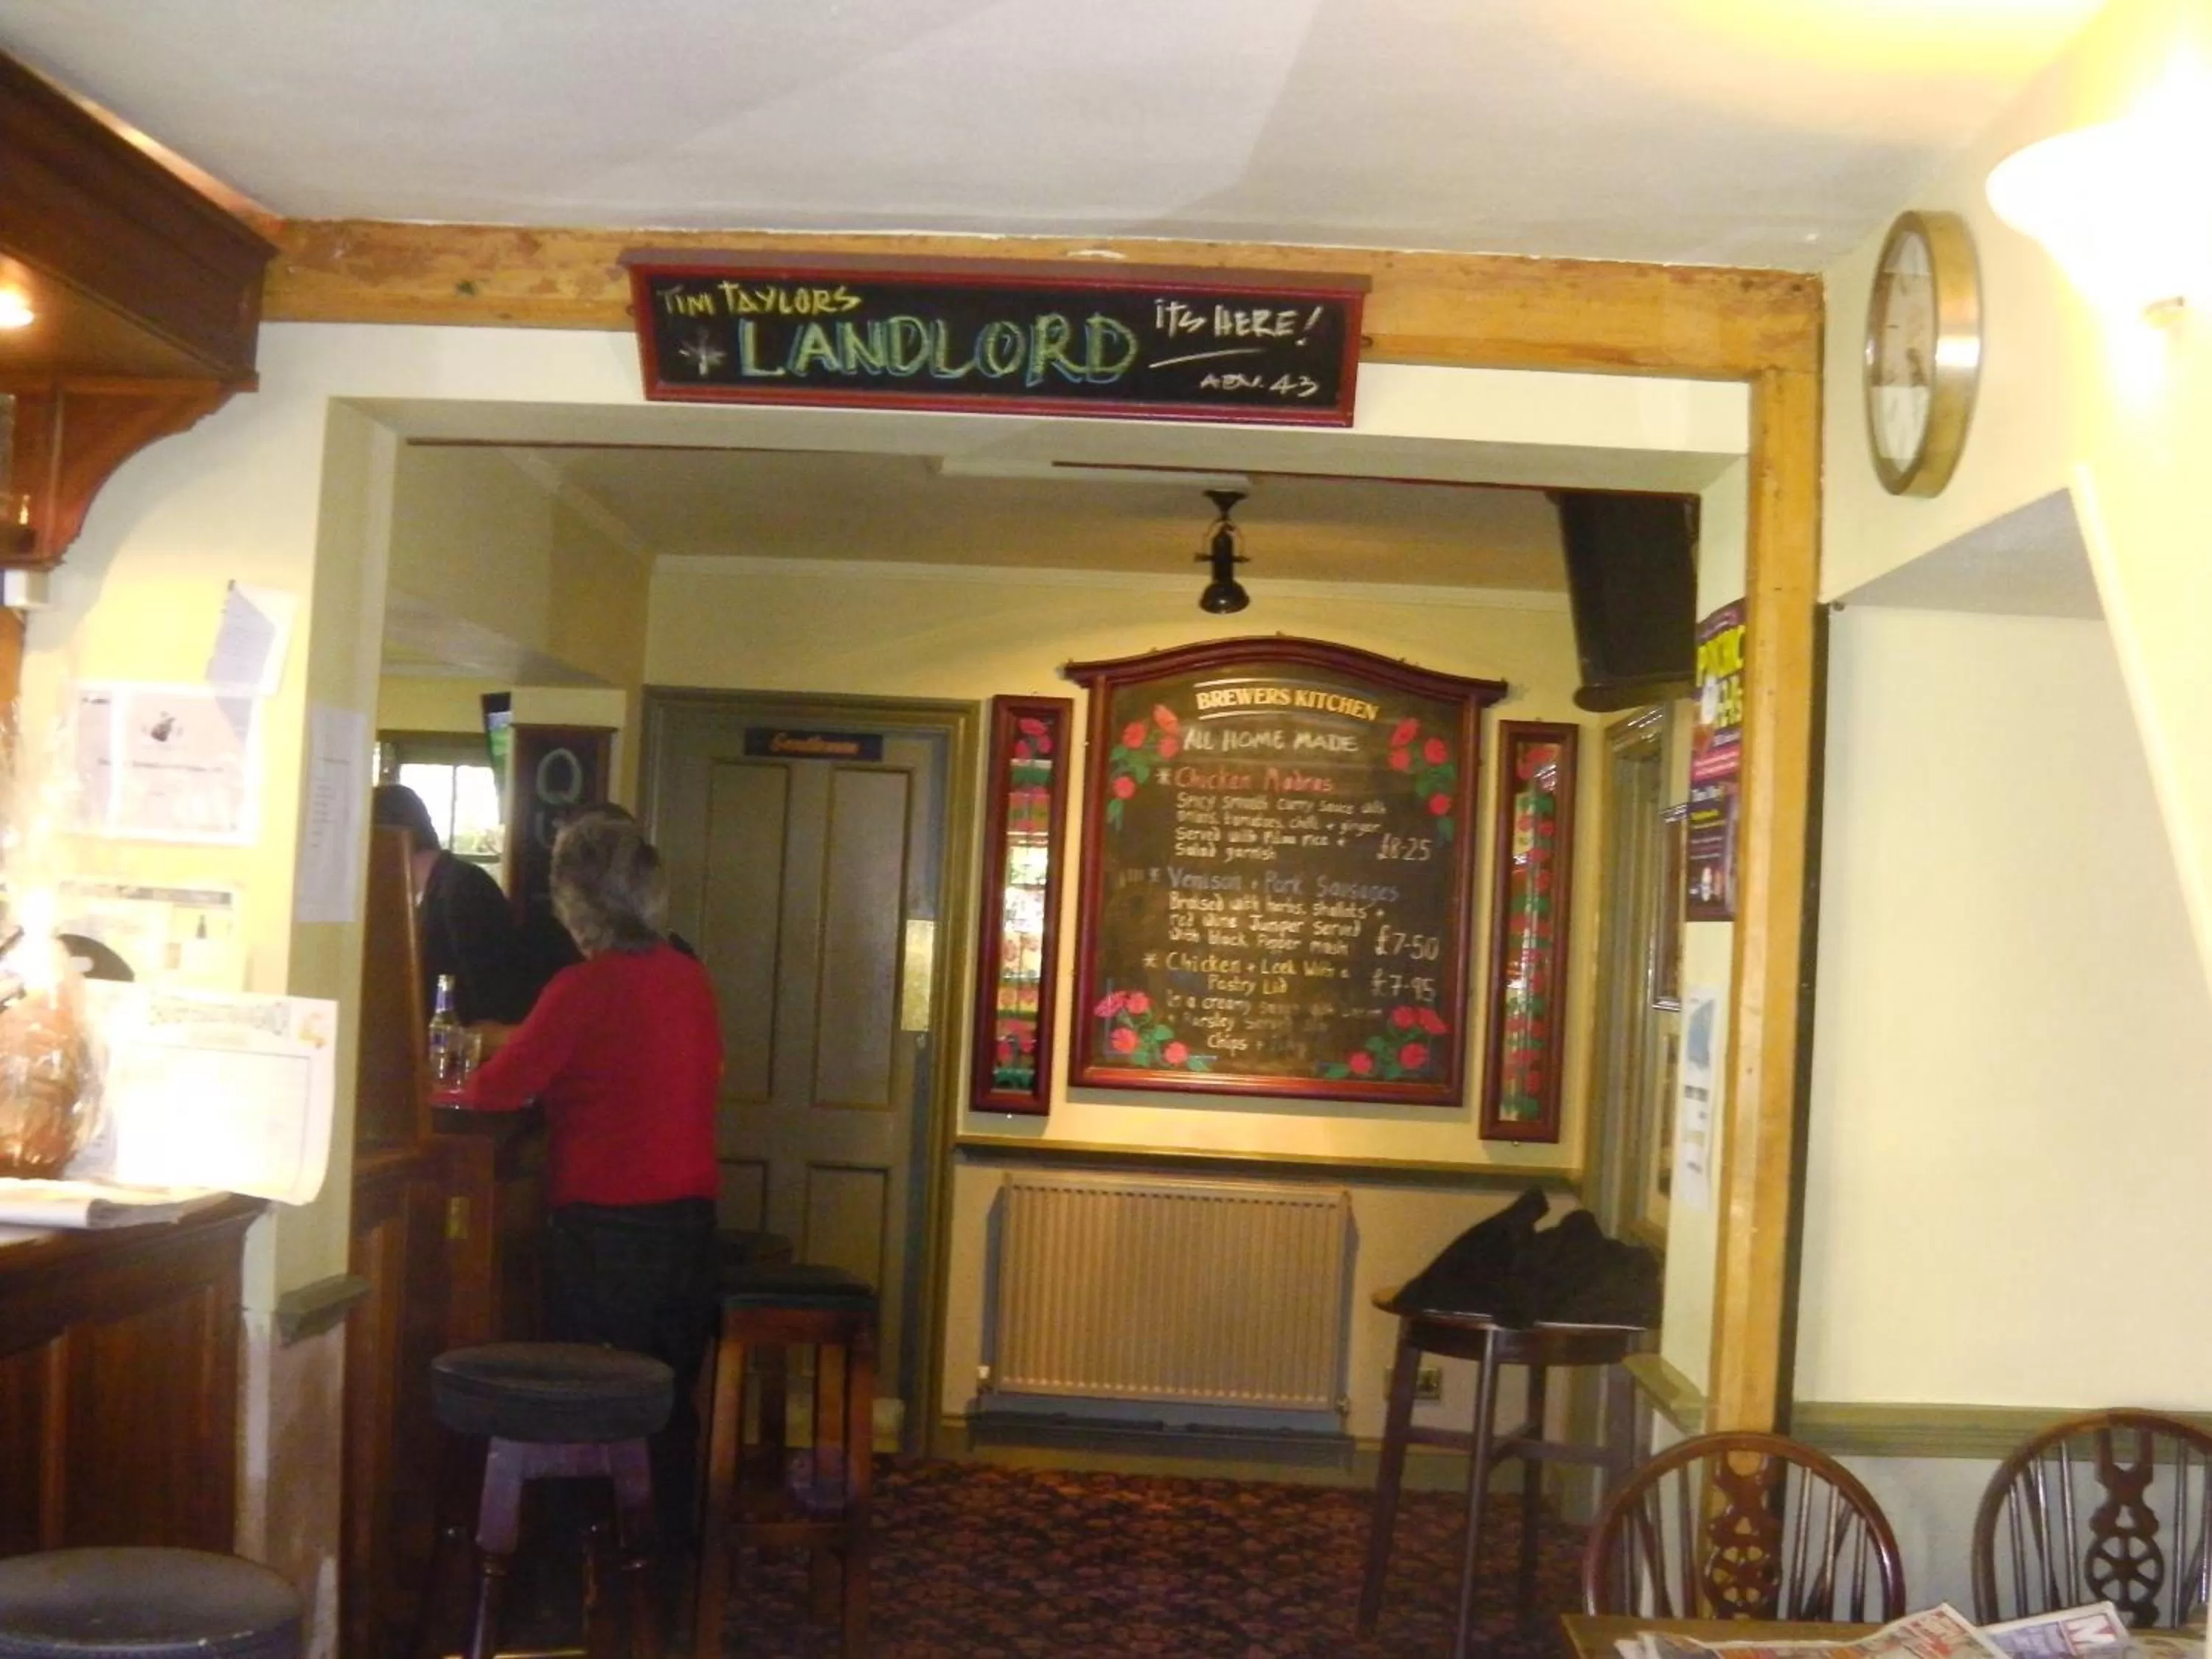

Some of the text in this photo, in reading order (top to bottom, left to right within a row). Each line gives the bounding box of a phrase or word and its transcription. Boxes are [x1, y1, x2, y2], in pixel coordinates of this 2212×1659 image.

[718, 280, 862, 316] TAYLORS
[738, 311, 1141, 387] LANDLORD
[1195, 687, 1380, 721] BREWERS KITCHEN
[1221, 728, 1286, 752] HOME
[1293, 729, 1360, 752] MADE
[1166, 951, 1242, 974] Chicken
[1208, 973, 1256, 996] Pastry
[1207, 1032, 1249, 1057] Chips
